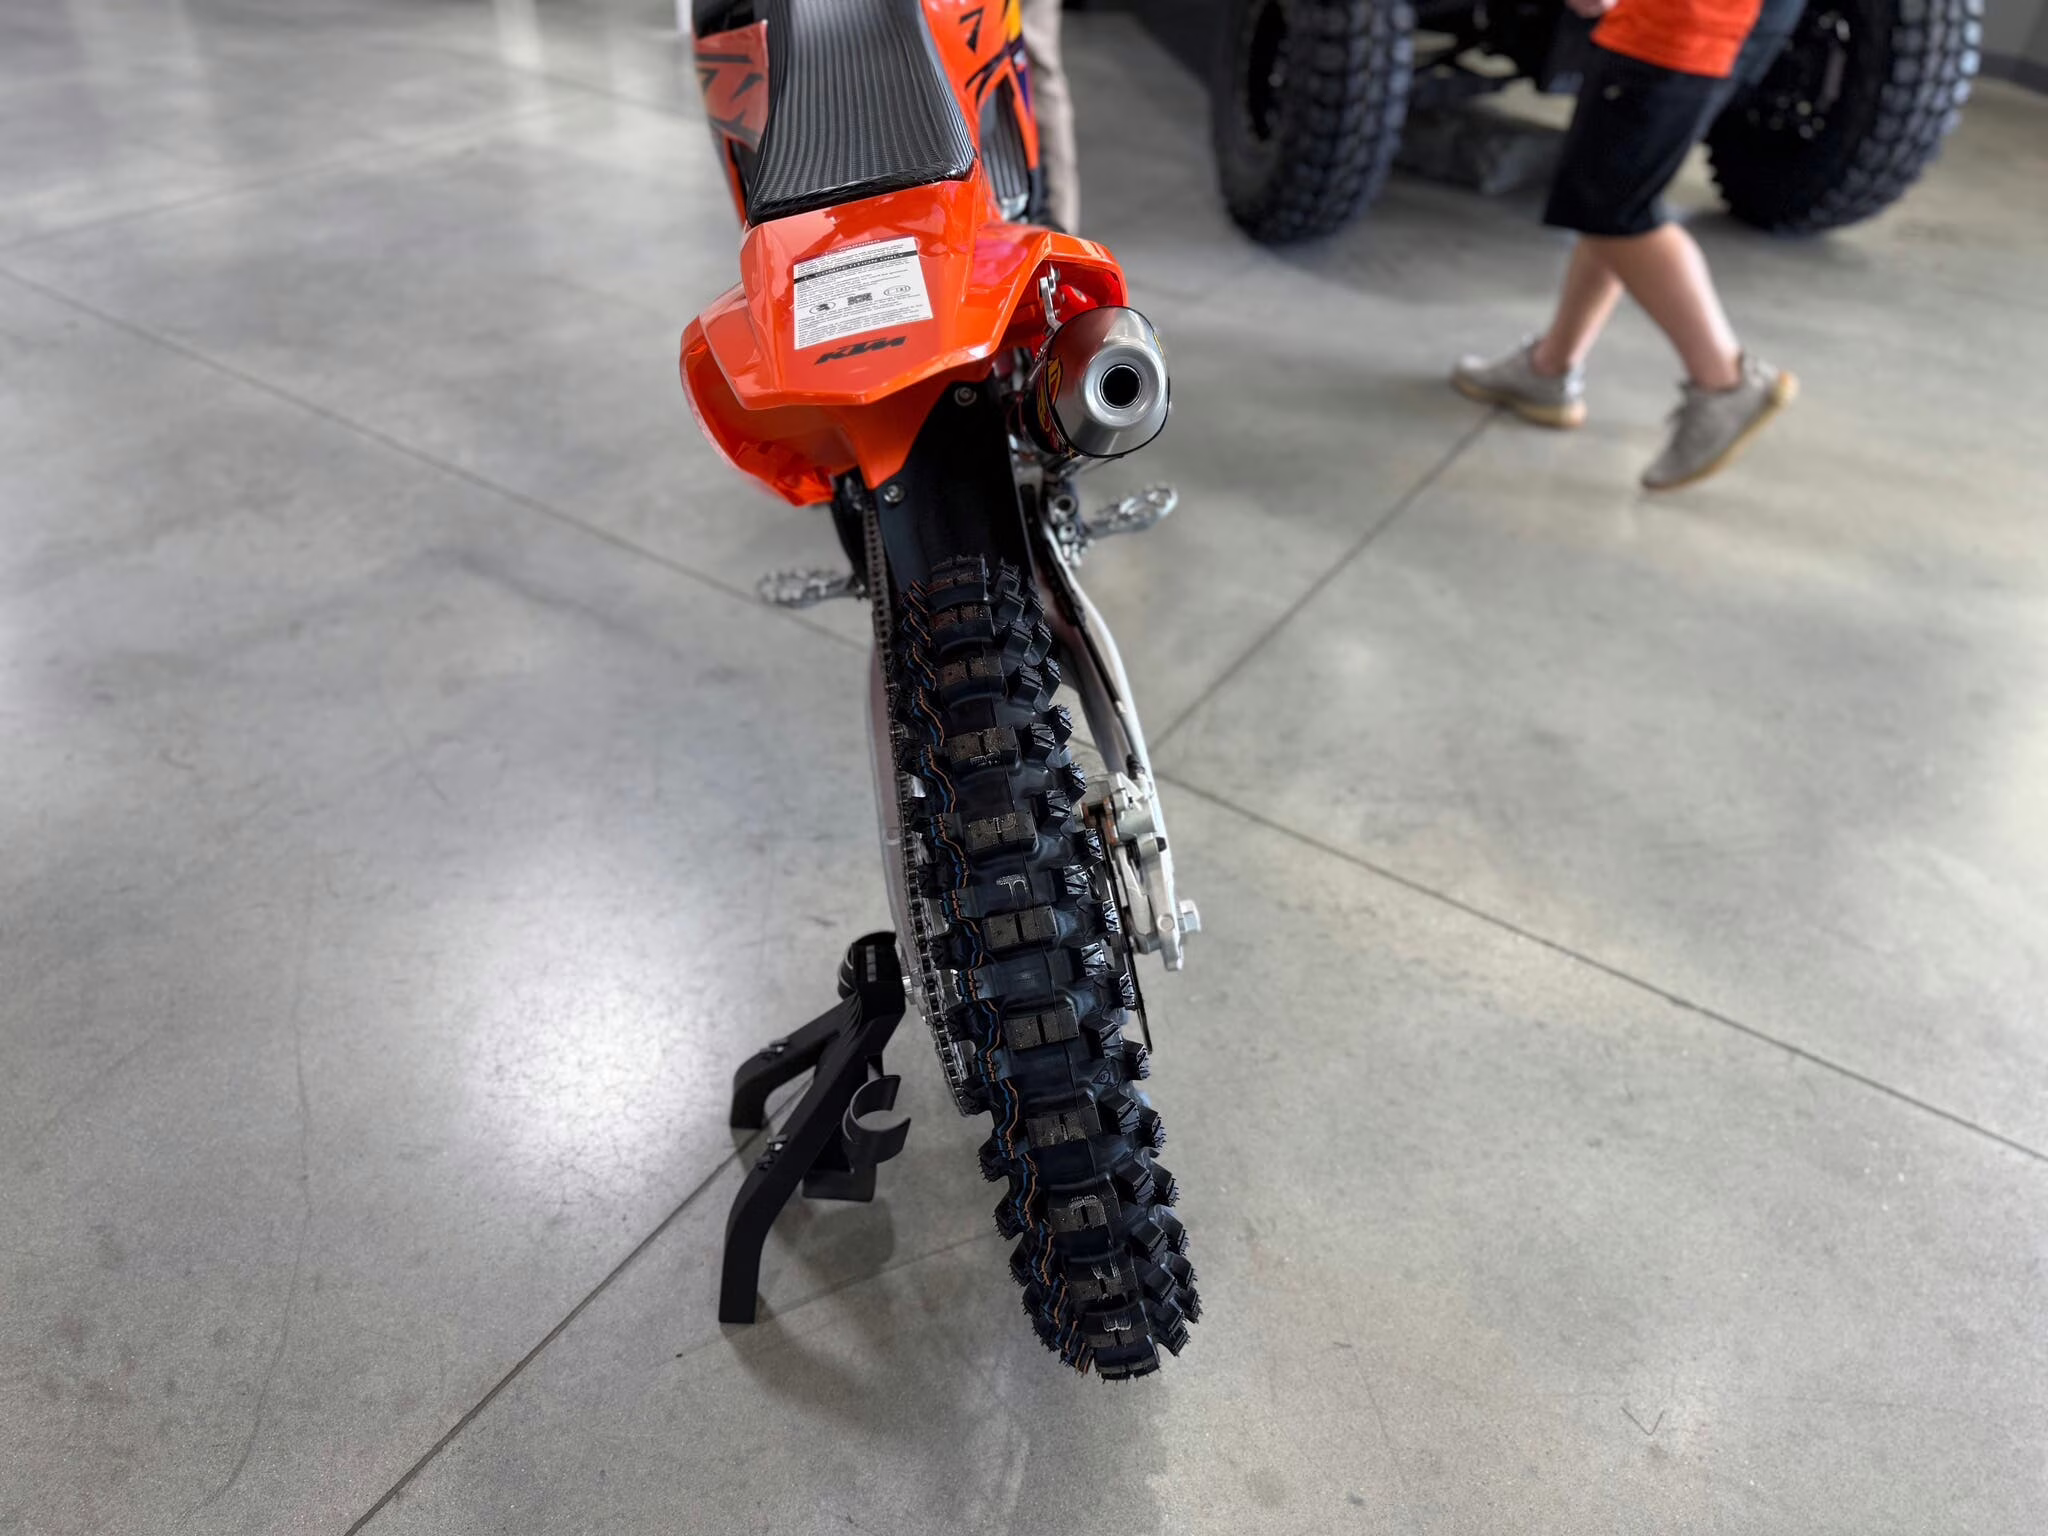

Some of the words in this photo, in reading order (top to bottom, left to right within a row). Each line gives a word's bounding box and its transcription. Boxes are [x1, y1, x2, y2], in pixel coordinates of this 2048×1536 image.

[815, 257, 878, 277] COMPETITION
[880, 253, 906, 263] ONLY
[814, 336, 908, 366] KTM
